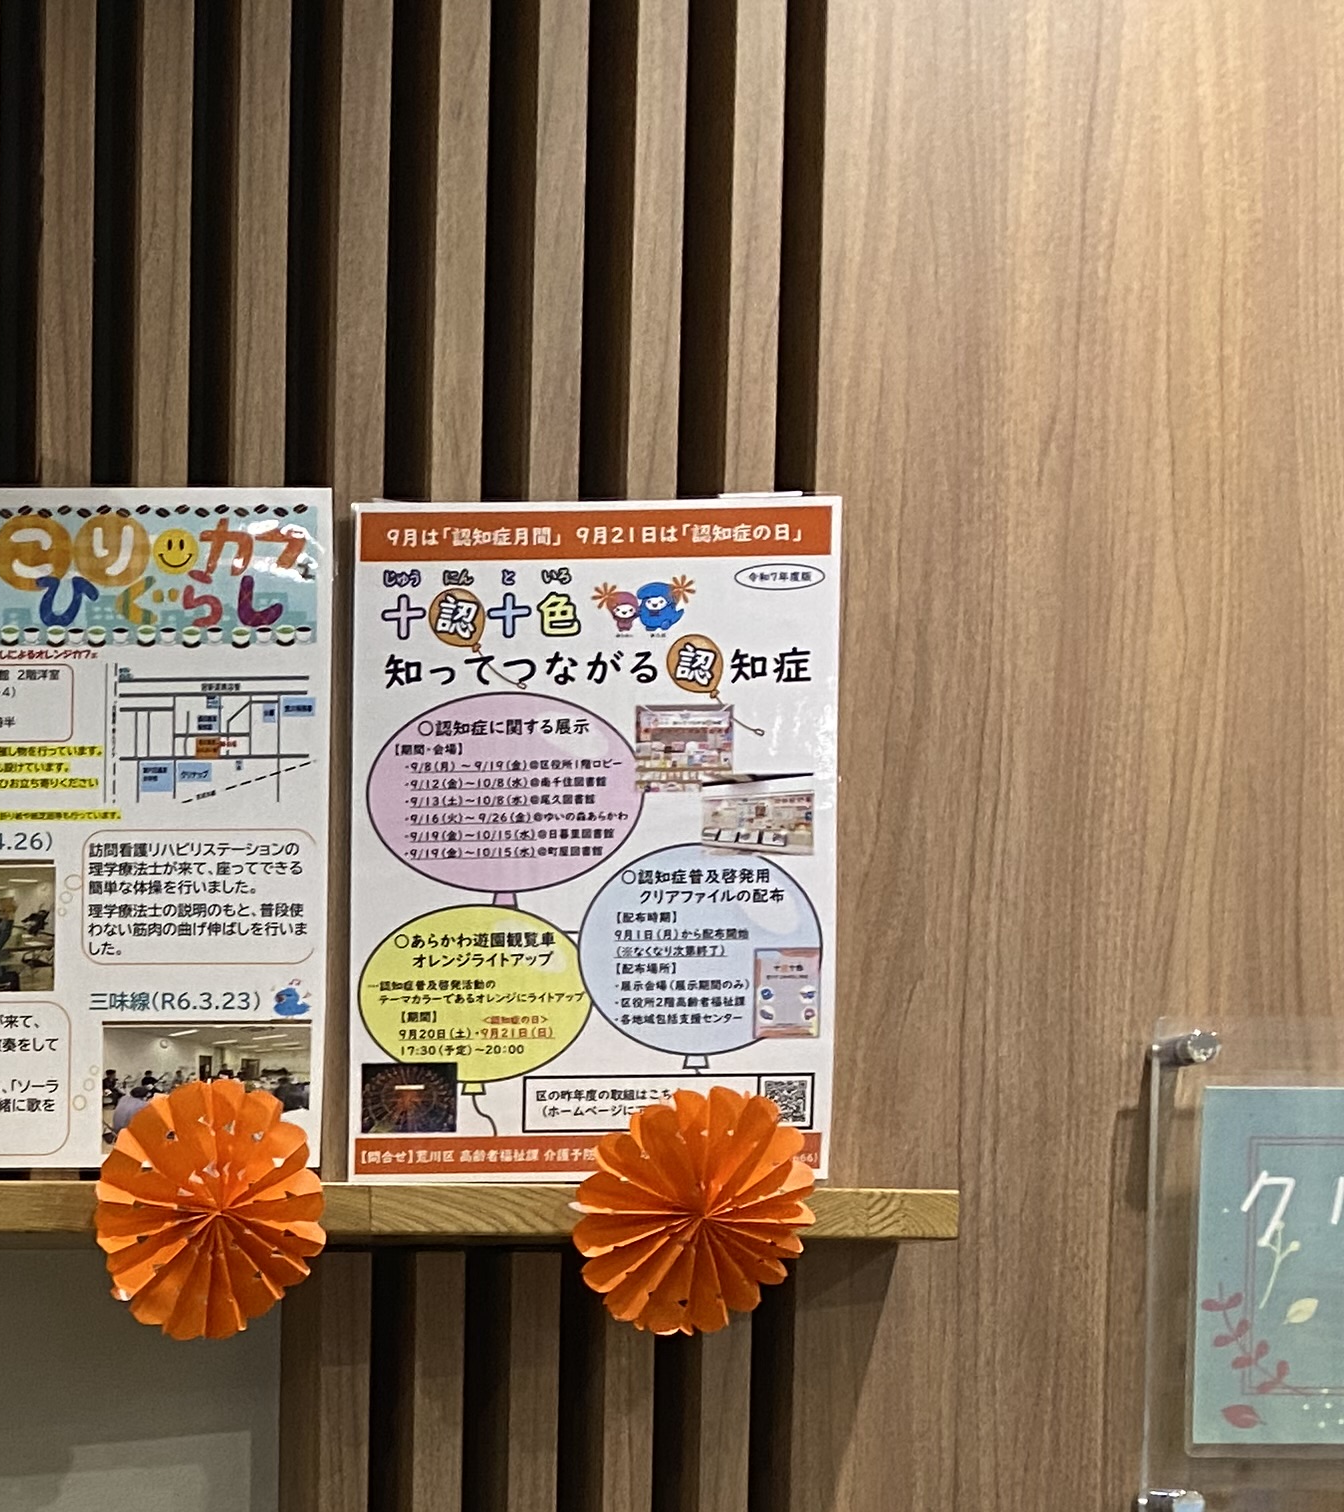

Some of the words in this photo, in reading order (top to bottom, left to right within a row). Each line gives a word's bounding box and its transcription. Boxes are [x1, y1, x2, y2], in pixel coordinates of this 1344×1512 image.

[383, 570, 421, 587] じゅう
[443, 569, 473, 586] にん
[502, 570, 515, 585] と
[541, 568, 572, 585] いろ
[37, 574, 284, 627] ひぐらし
[385, 646, 812, 690] 知ってつながる認知症
[88, 841, 300, 857] 訪問看護リハビリステーションの
[88, 861, 303, 877] 理学療法士が来て、座ってできる
[88, 880, 259, 895] 簡単な体操を行いました。
[639, 888, 785, 904] クリアファイルの配布
[88, 903, 304, 919] 理学療法士の説明のもと、普段使
[88, 922, 308, 938] わない筋肉の曲げ伸ばしを行いま
[88, 942, 123, 956] した。
[412, 951, 555, 968] オレンジライトアップ
